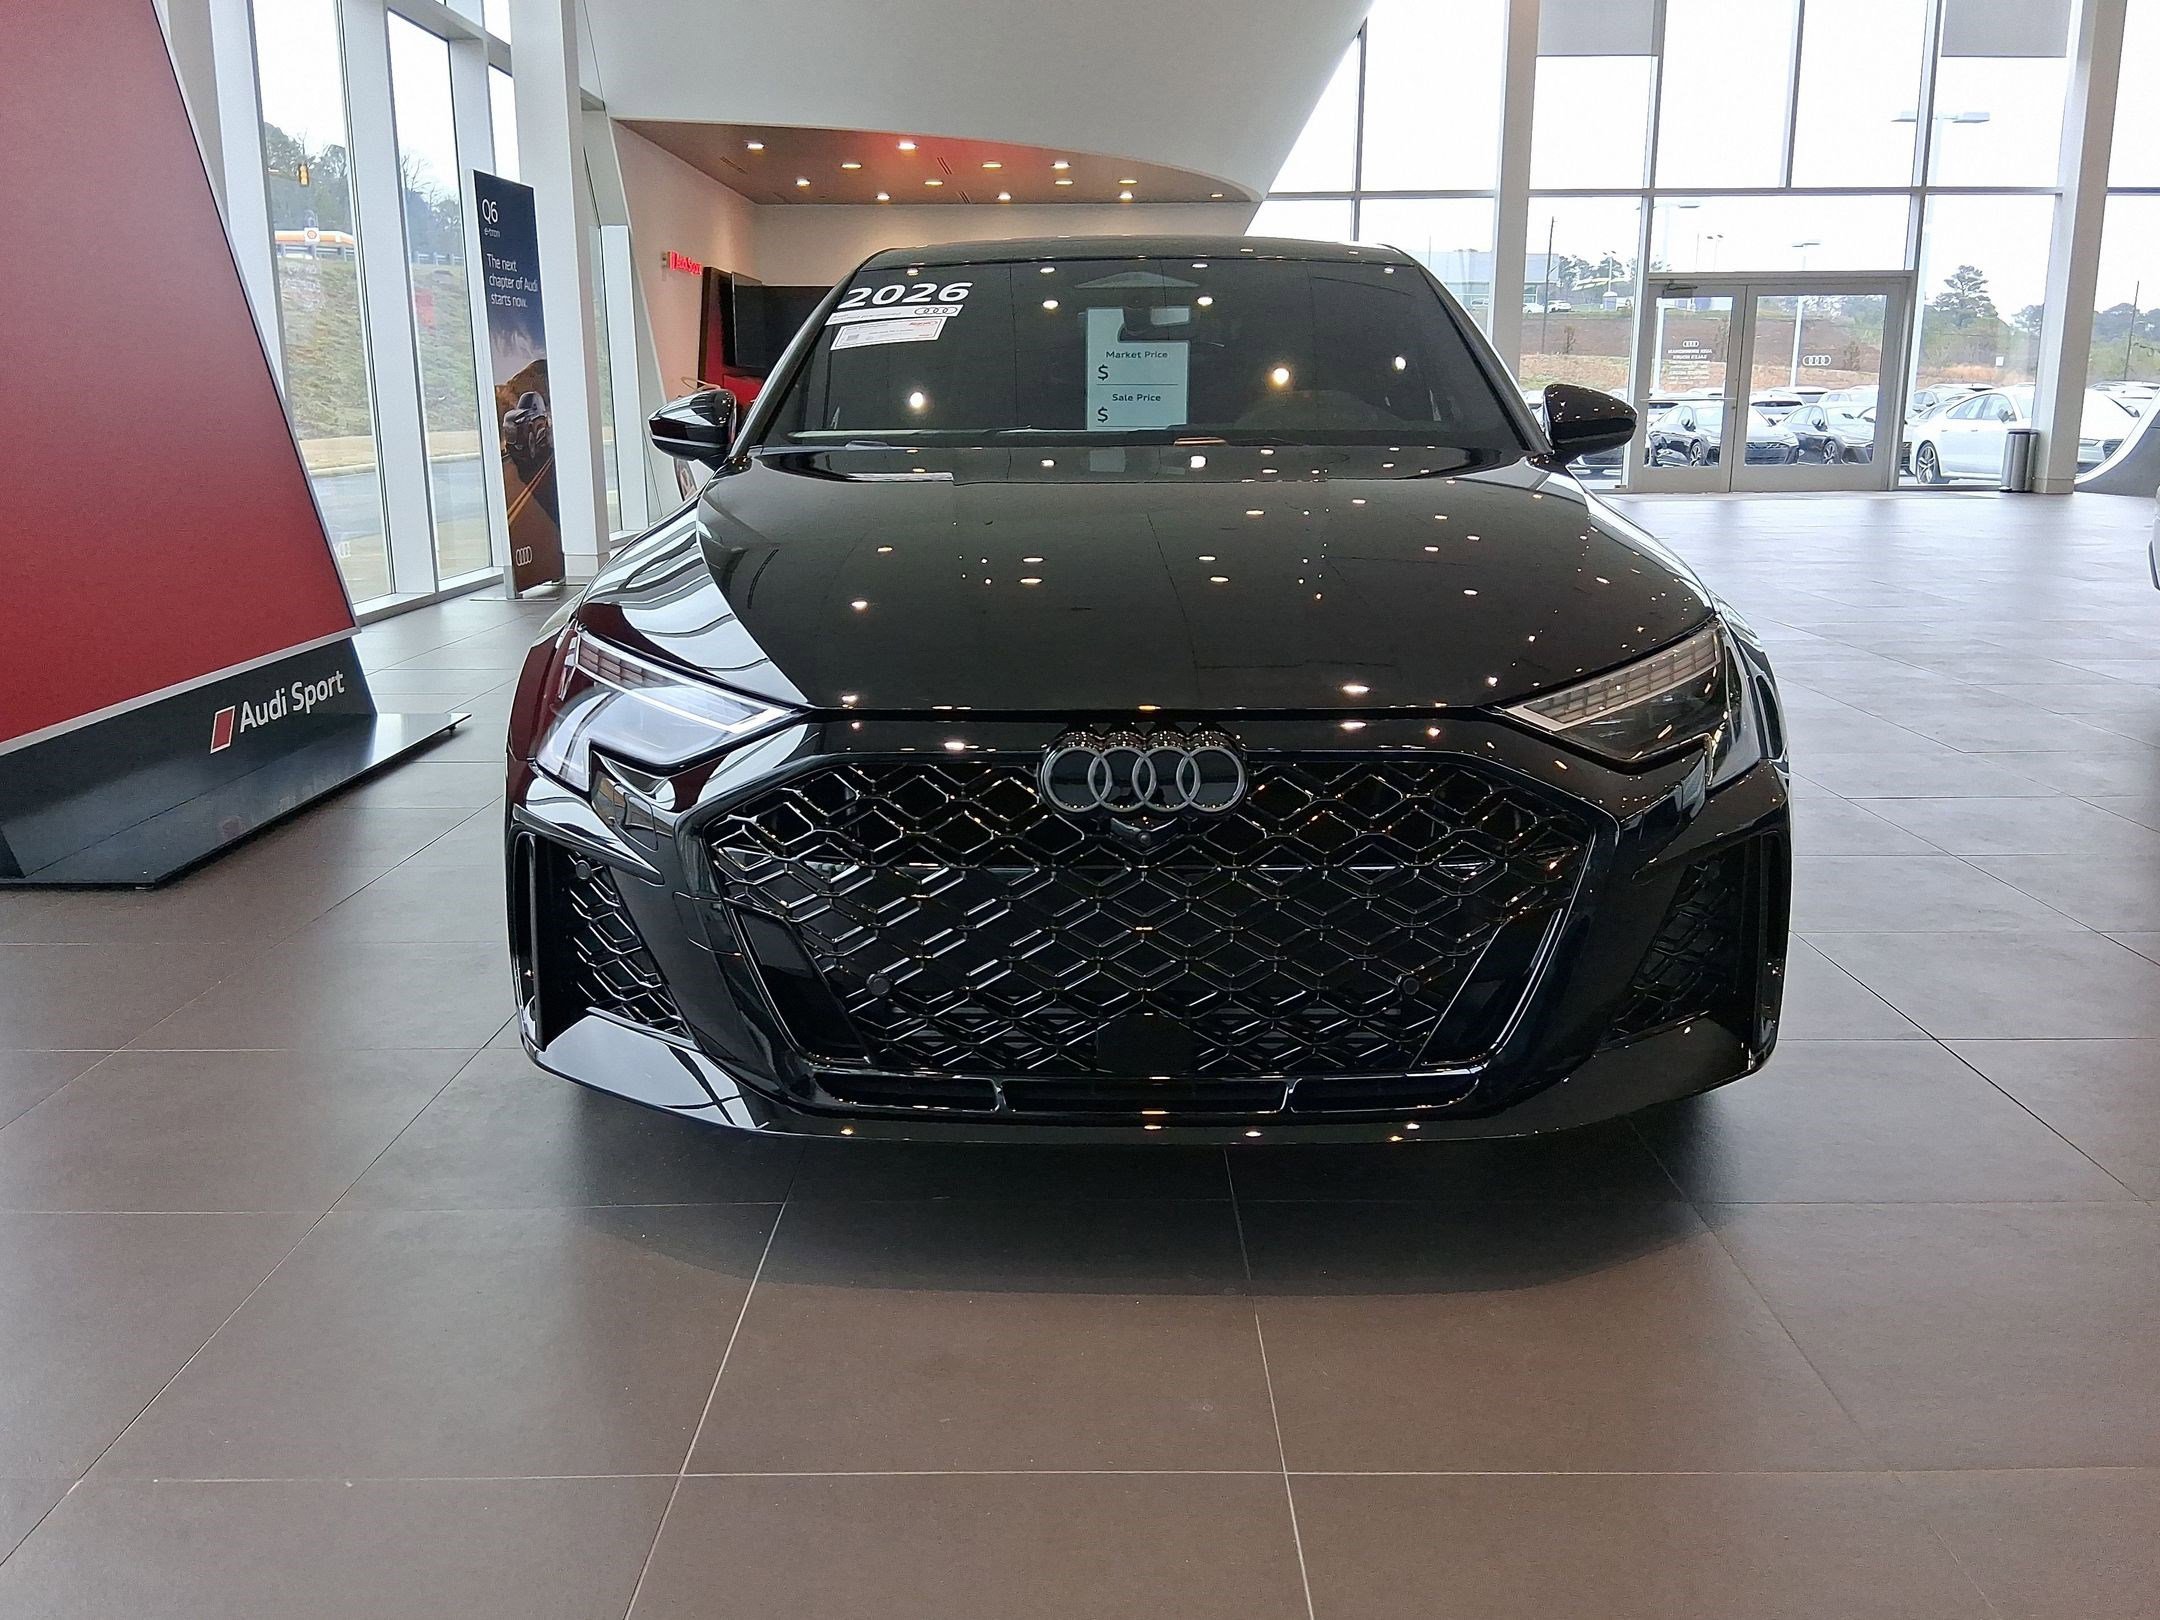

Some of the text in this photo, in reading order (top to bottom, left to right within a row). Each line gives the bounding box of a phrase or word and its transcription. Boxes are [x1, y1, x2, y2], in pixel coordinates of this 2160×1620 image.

[482, 199, 498, 224] Q6
[487, 253, 518, 272] The next
[489, 273, 538, 292] chapter of Audi
[491, 293, 528, 308] starts now.
[837, 282, 973, 309] 2026
[1105, 351, 1168, 359] Market Price
[1097, 364, 1109, 380] $
[1112, 393, 1161, 402] Sale Price
[1097, 406, 1109, 423] $
[240, 670, 345, 733] Audi Sport
